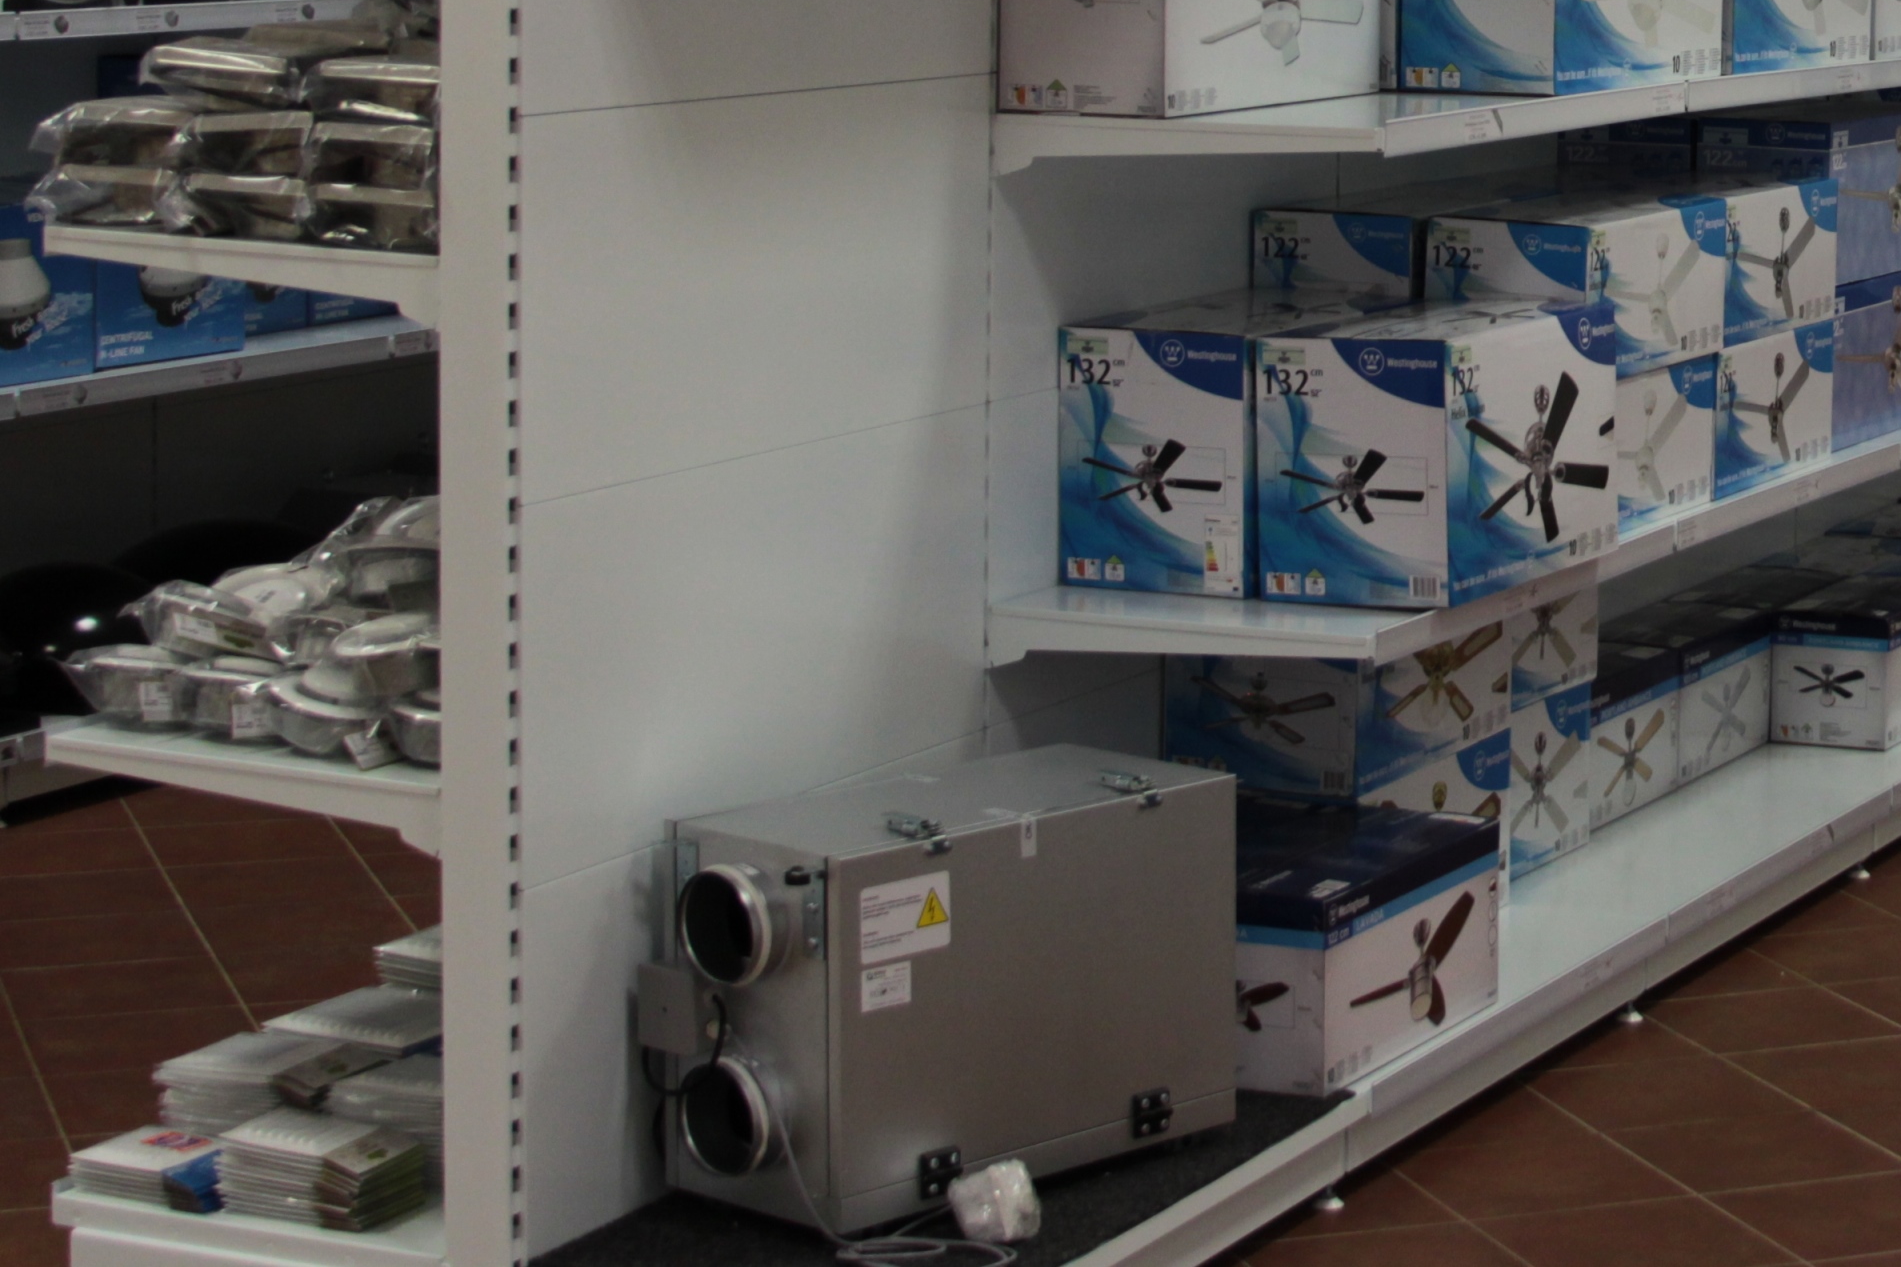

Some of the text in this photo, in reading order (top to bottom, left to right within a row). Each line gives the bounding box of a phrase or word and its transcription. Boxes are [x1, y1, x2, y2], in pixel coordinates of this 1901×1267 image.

[1672, 55, 1681, 74] 10
[1704, 149, 1732, 167] 122
[1261, 236, 1300, 259] 122
[1432, 243, 1471, 270] 122
[1590, 248, 1606, 272] 122
[99, 330, 154, 347] CENTRIFUGAL
[1187, 349, 1237, 363] Westinghouse
[1387, 356, 1439, 371] Westinghouse
[1068, 357, 1126, 386] 132 cm
[1263, 368, 1324, 397] 132 cm
[1452, 366, 1474, 397] 132
